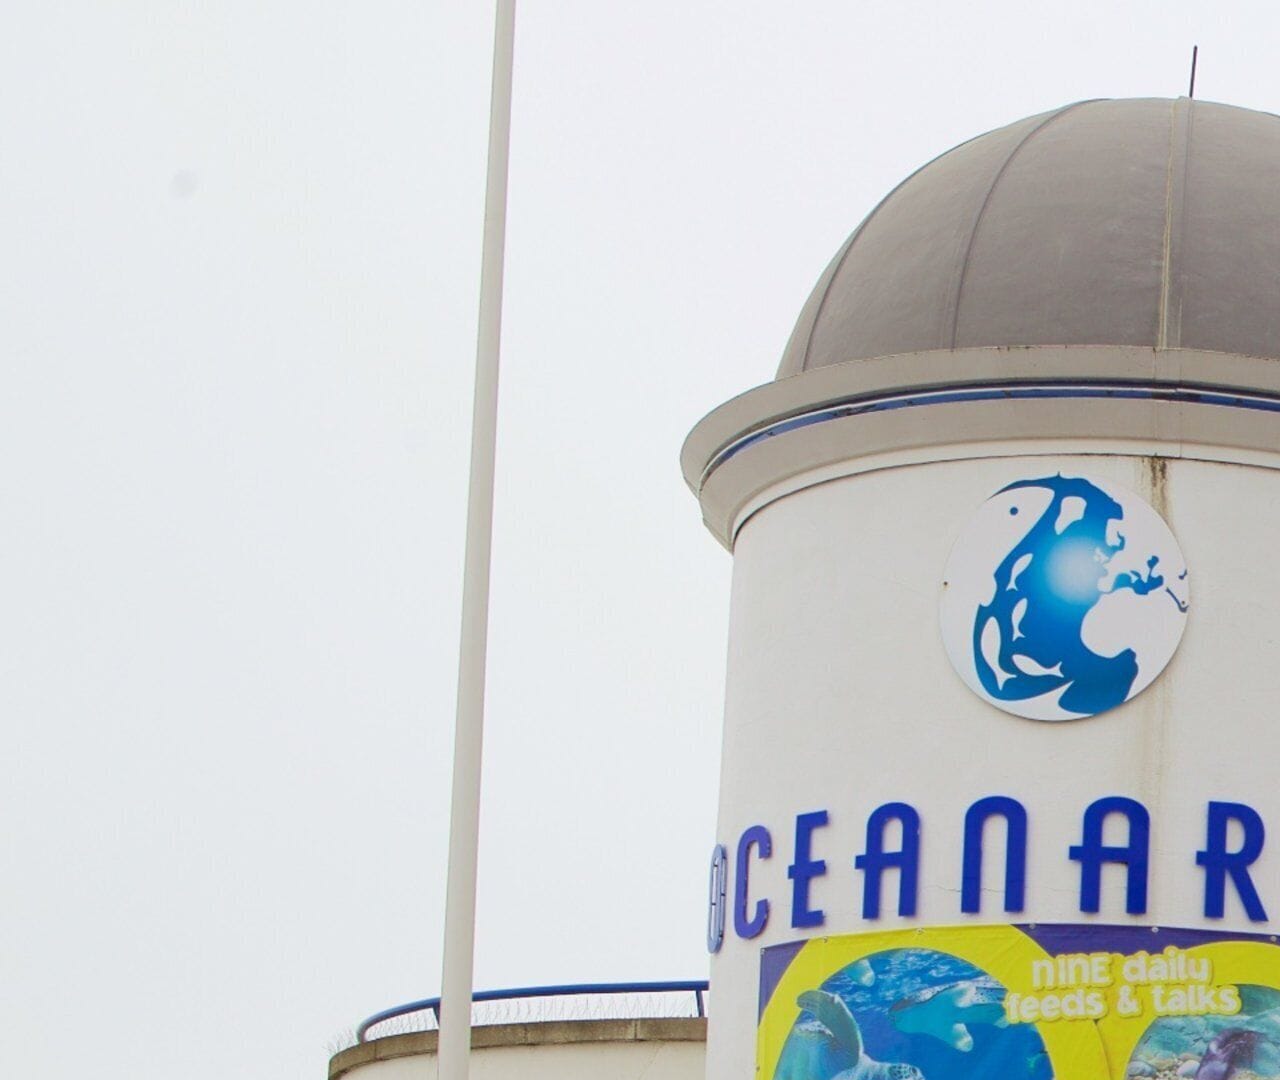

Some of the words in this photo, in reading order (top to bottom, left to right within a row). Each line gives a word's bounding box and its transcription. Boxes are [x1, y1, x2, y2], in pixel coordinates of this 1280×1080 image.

[1122, 948, 1210, 983] daily
[1006, 988, 1106, 1018] feeds
[1116, 984, 1140, 1014] &
[1151, 984, 1239, 1013] talks
